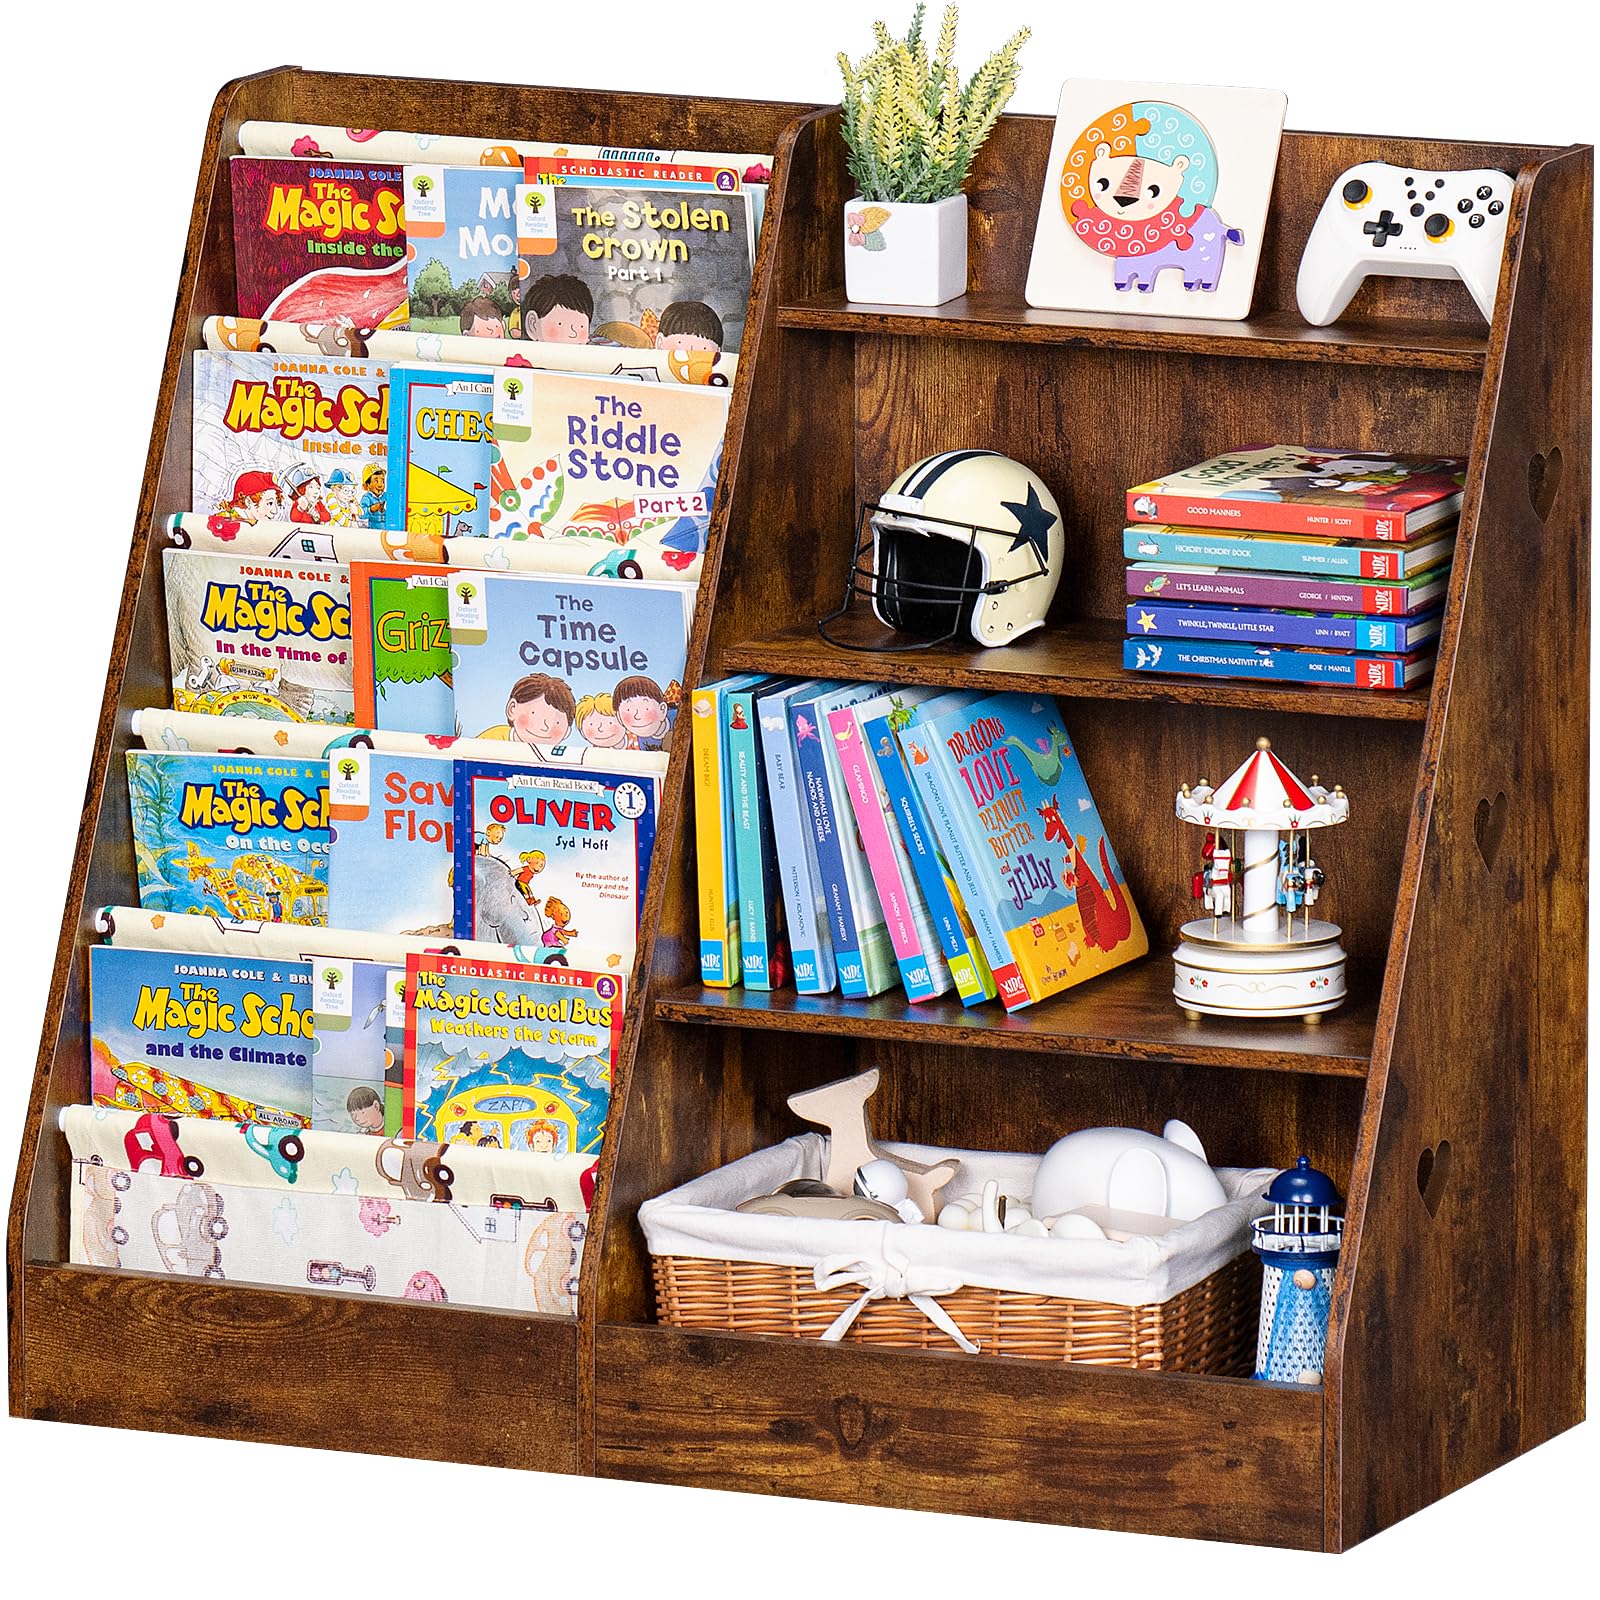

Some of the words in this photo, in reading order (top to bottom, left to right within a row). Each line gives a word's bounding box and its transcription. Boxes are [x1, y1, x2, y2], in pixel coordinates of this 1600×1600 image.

[310, 168, 364, 180] JOANNA
[369, 170, 402, 182] COLE
[561, 164, 645, 178] SCHOLASTIC
[654, 170, 703, 181] READER
[722, 175, 730, 186] 2
[313, 183, 351, 200] The
[1479, 188, 1487, 196] X
[267, 186, 371, 238] Magic
[571, 207, 616, 227] The
[622, 202, 730, 232] Stolen
[1471, 216, 1478, 224] B
[307, 240, 365, 255] Inside
[372, 242, 403, 257] the
[582, 233, 689, 262] Crown
[608, 265, 650, 281] Part
[654, 268, 662, 281] 1
[273, 363, 327, 374] JOANNA
[334, 366, 367, 376] COLE
[376, 368, 386, 378] &
[276, 379, 316, 398] The
[455, 383, 469, 392] An
[470, 384, 474, 392] I
[476, 384, 492, 394] Can
[227, 383, 334, 437] Magic
[595, 396, 642, 418] The
[568, 415, 682, 456] Riddle
[303, 439, 362, 454] Inside
[567, 448, 679, 489] Stone
[1180, 460, 1249, 479] Good
[638, 497, 685, 513] Part
[692, 496, 703, 512] 2
[1187, 506, 1208, 515] GOOD
[1209, 508, 1241, 517] MANNERS
[1307, 516, 1330, 524] HUNTER
[1335, 517, 1352, 526] SCOTT
[1175, 545, 1199, 554] HICKORY
[1200, 546, 1230, 556] DICKORY
[1232, 549, 1251, 558] DOCK
[240, 566, 293, 579] JOANNA
[298, 572, 331, 583] COLE
[340, 575, 349, 584] &
[415, 576, 429, 586] An
[431, 578, 436, 586] I
[248, 583, 286, 602] The
[1193, 585, 1213, 593] LEARN
[1214, 586, 1244, 595] ANIMALS
[1299, 592, 1323, 600] GEORGE
[555, 594, 594, 612] The
[204, 586, 304, 639] Magic
[537, 615, 617, 643] Time
[1238, 623, 1258, 632] LITTLE
[1259, 624, 1274, 633] STAR
[216, 640, 234, 654] In
[241, 643, 272, 658] the
[276, 646, 322, 663] Time
[328, 652, 347, 664] of
[519, 641, 648, 676] Capsule
[1178, 654, 1191, 662] THE
[1192, 655, 1227, 665] CHRISTMAS
[1228, 657, 1258, 667] NATIVITY
[213, 765, 262, 775] JOANNA
[267, 767, 297, 777] COLE
[305, 769, 313, 778] &
[960, 747, 1020, 808] LOVE
[223, 782, 260, 799] The
[384, 771, 454, 806] Sav
[534, 779, 552, 789] Can
[552, 780, 573, 790] Read
[573, 782, 594, 792] Book
[618, 784, 640, 796] LEVEL
[853, 764, 868, 804] GLAMINGO
[183, 785, 278, 833] Magic
[626, 791, 636, 809] 1
[806, 772, 817, 800] NACHOS
[812, 802, 820, 817] AND
[816, 818, 826, 842] CHEESE
[816, 777, 828, 816] NARWHALS
[824, 816, 832, 834] LOVE
[490, 795, 616, 832] OLIVER
[979, 788, 1028, 832] PEANUT
[555, 836, 575, 849] Syd
[582, 838, 609, 851] Hoff
[925, 772, 939, 801] DRAGONS
[937, 800, 946, 818] LOVE
[944, 818, 957, 844] PEANUT
[954, 845, 966, 868] BUTTER
[963, 867, 972, 882] AND
[968, 882, 978, 897] JELLY
[988, 822, 1034, 859] BUTTER
[225, 835, 253, 850] On
[259, 837, 292, 852] the
[298, 839, 330, 854] Oce
[913, 832, 926, 856] SECRET
[1000, 860, 1010, 875] and
[174, 965, 228, 978] JOANNA
[232, 970, 265, 981] COLE
[272, 972, 282, 983] &
[420, 972, 446, 988] The
[441, 964, 526, 980] SCHOLASTIC
[533, 973, 584, 986] READER
[180, 983, 218, 1001] The
[602, 981, 610, 991] 2
[133, 985, 235, 1039] Magic
[414, 989, 490, 1016] Magic
[494, 993, 568, 1023] School
[571, 998, 612, 1027] Bus
[430, 1019, 509, 1039] Weathers
[514, 1026, 543, 1042] the
[549, 1029, 597, 1047] Storm
[146, 1042, 184, 1057] and
[190, 1044, 223, 1060] the
[229, 1047, 307, 1067] Climate
[488, 1100, 526, 1112] ZAP!
[258, 1112, 271, 1121] ALL
[272, 1116, 300, 1128] ABOARD
